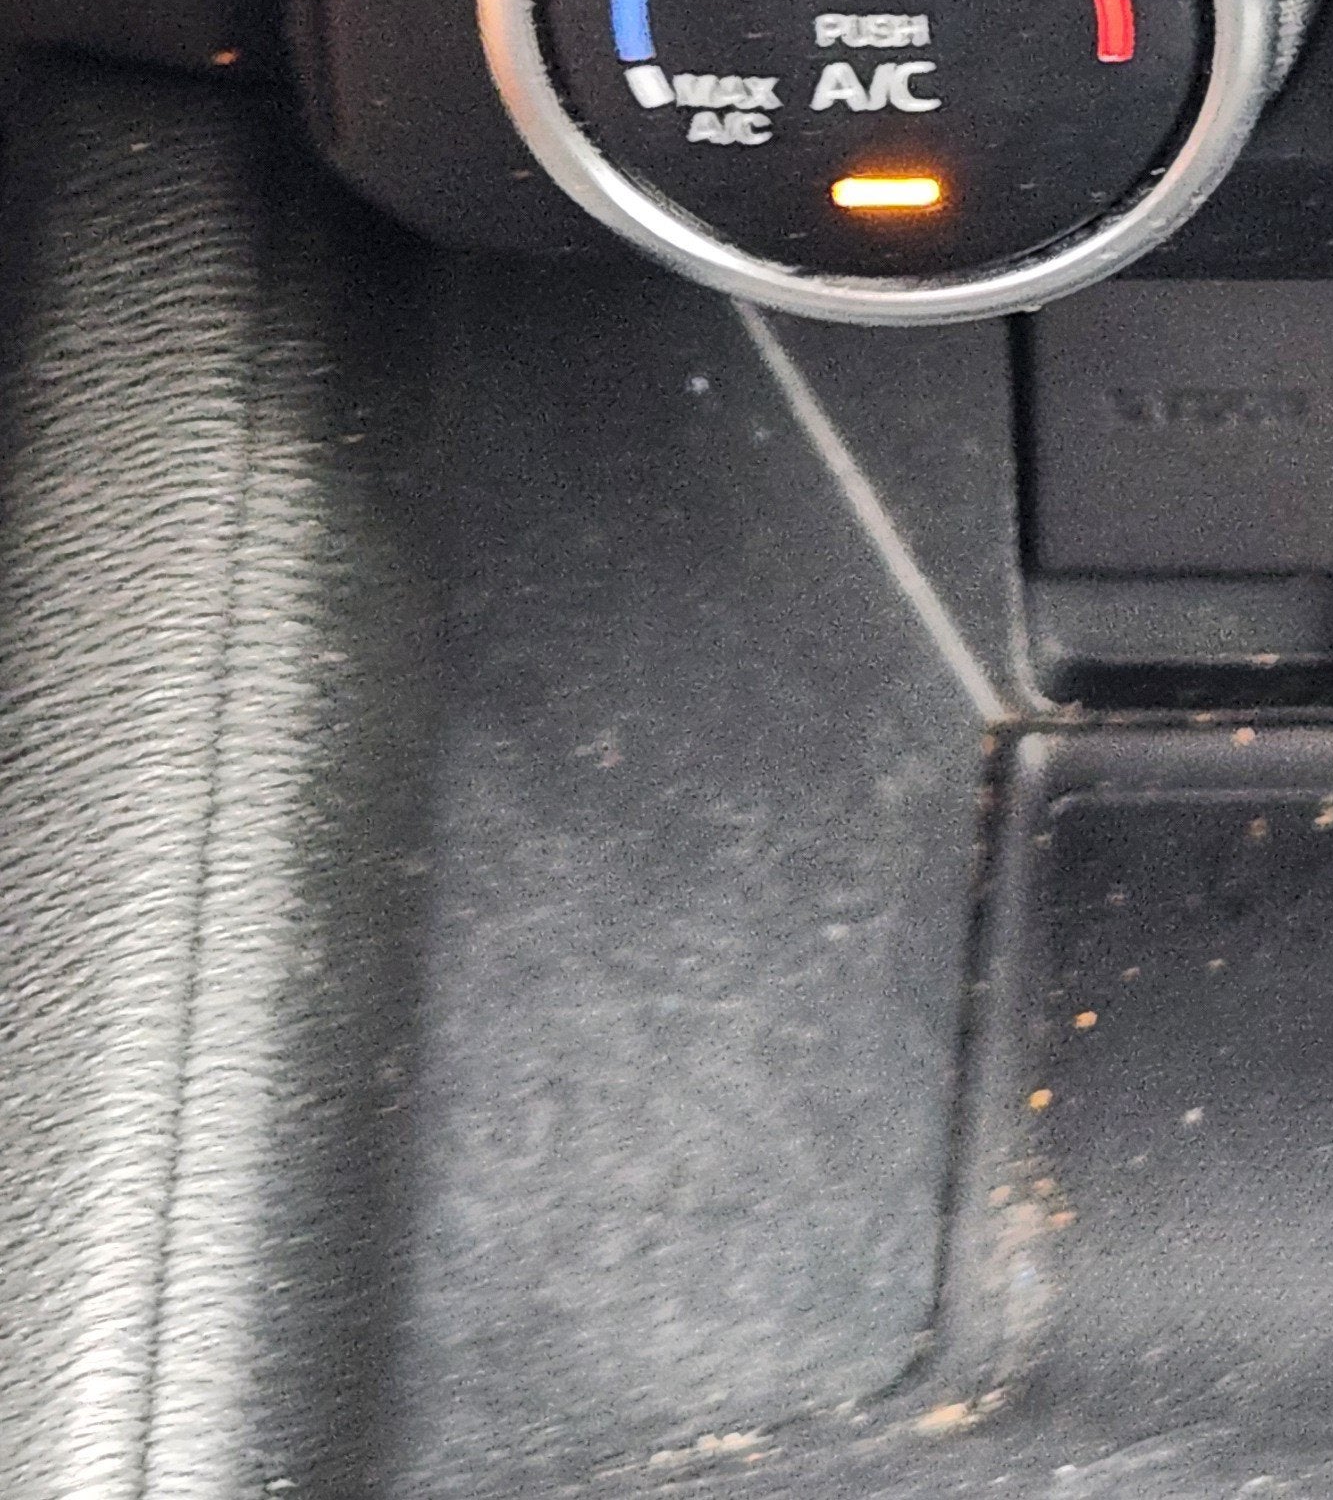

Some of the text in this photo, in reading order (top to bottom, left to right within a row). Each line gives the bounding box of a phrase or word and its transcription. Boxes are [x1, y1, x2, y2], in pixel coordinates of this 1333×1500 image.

[815, 13, 931, 47] PUSH
[673, 74, 784, 110] MAX
[810, 62, 942, 112] A/C
[687, 112, 774, 145] A/C
